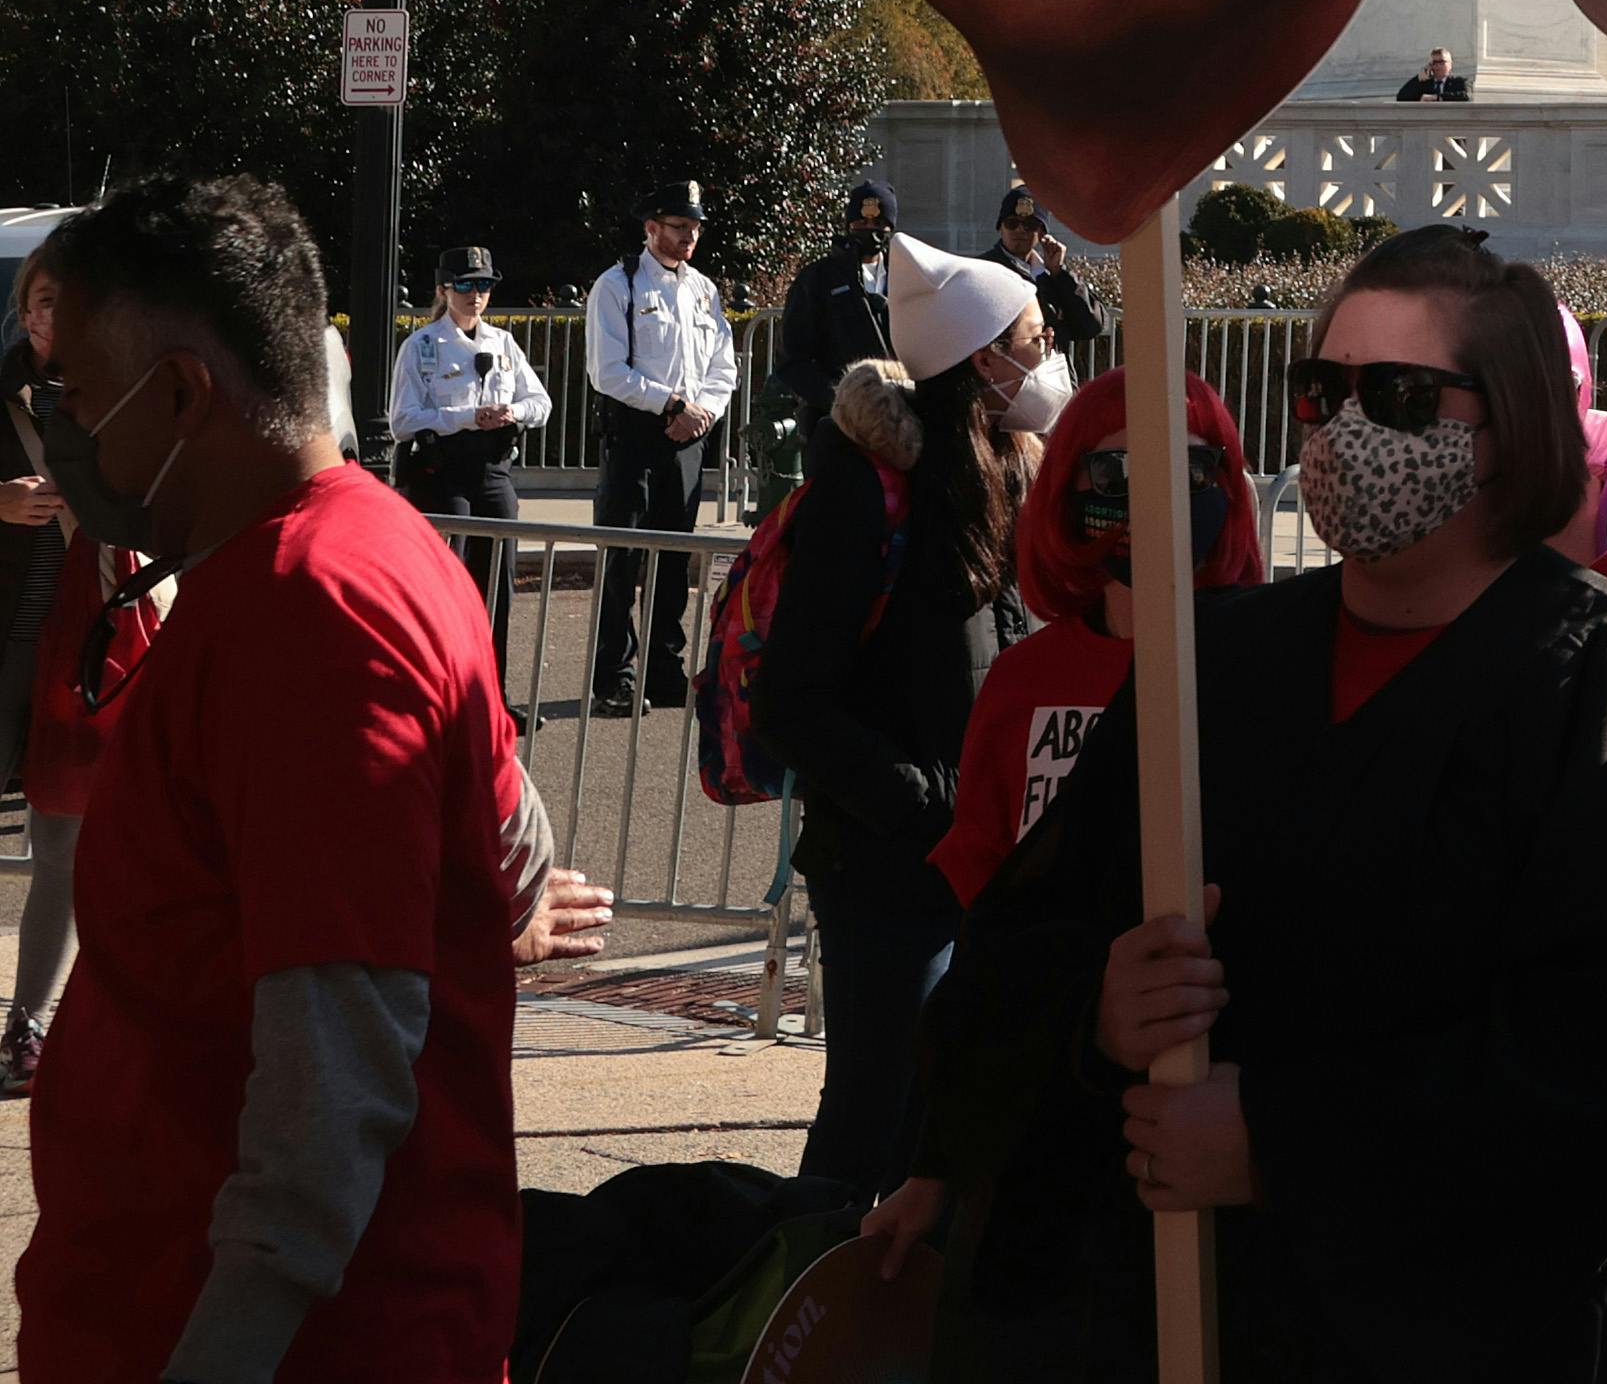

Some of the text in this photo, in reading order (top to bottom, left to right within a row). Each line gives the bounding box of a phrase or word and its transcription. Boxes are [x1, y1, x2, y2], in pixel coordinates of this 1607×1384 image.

[366, 18, 386, 34] NO
[348, 37, 402, 52] PARKING
[351, 55, 398, 68] HERE TO
[352, 70, 395, 83] CORNER
